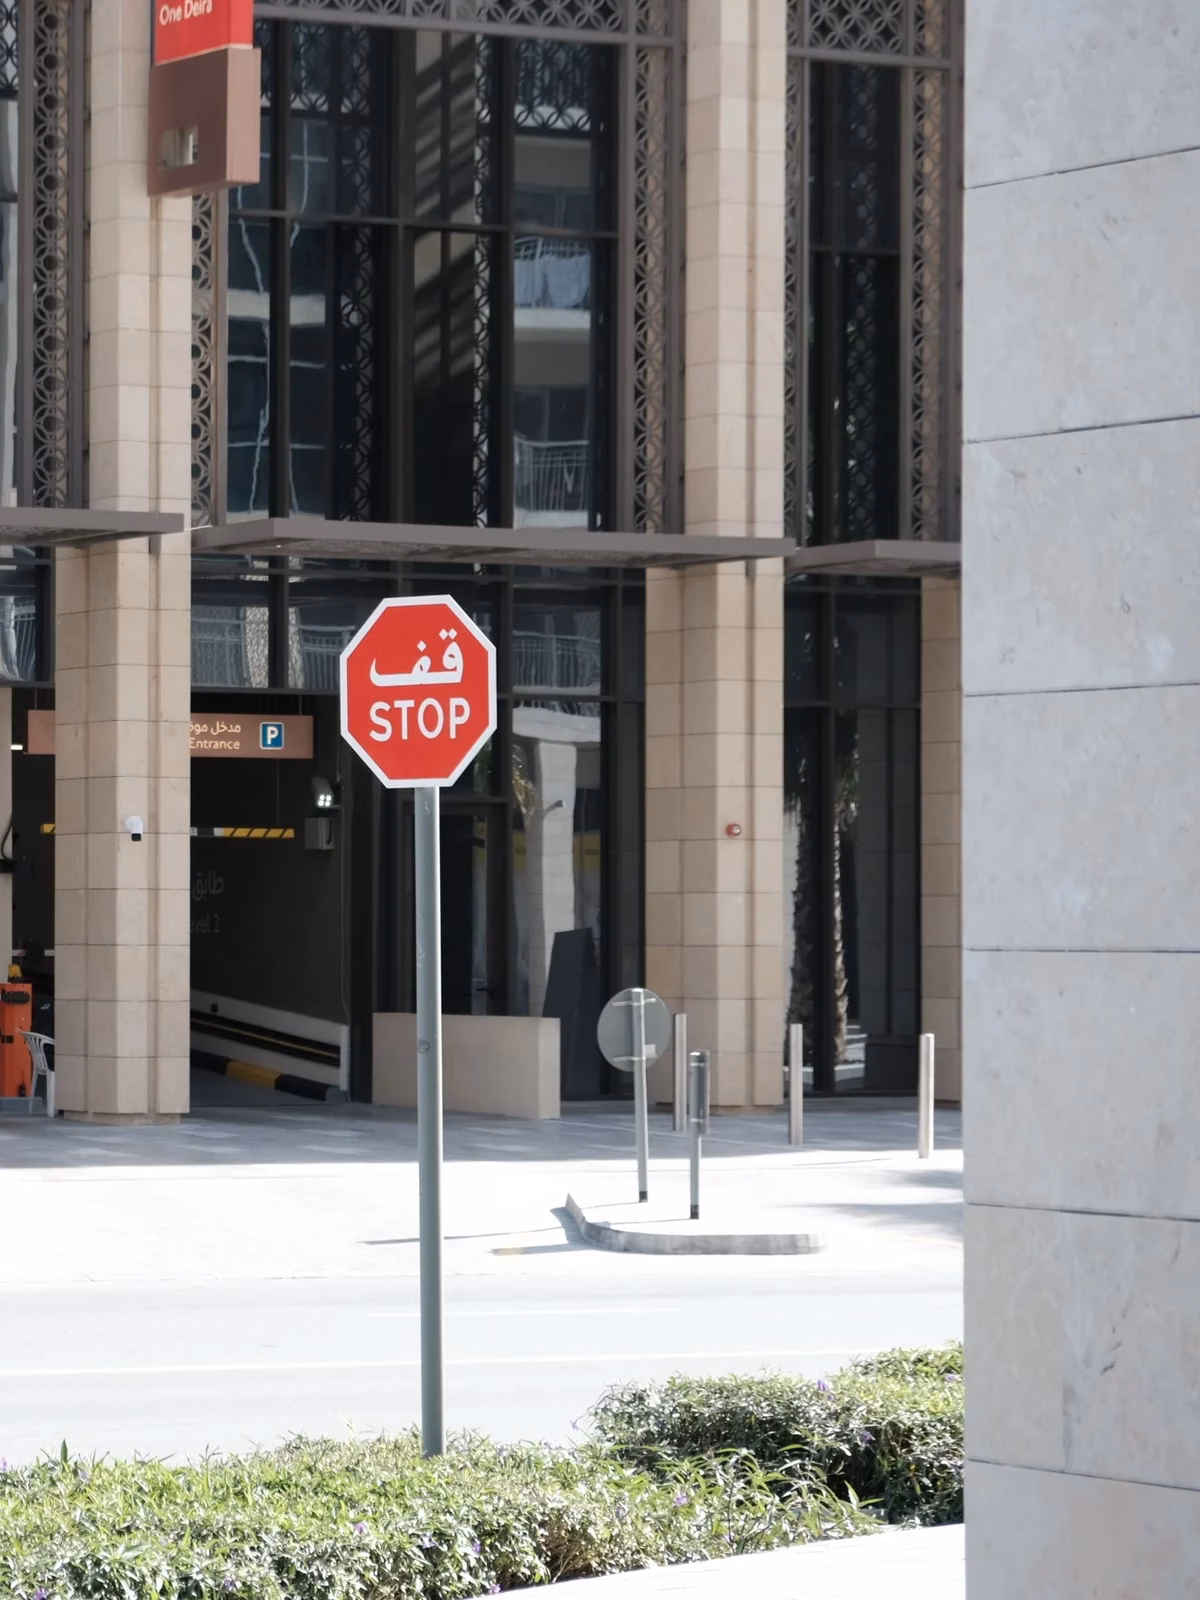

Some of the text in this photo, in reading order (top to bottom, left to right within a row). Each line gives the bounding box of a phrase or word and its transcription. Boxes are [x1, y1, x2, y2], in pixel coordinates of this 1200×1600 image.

[160, 0, 213, 26] One Deira
[369, 628, 464, 687] قف
[210, 720, 242, 736] مدخل
[369, 697, 471, 742] STOP
[190, 737, 241, 750] Entrance
[266, 725, 279, 745] P
[191, 870, 225, 902] طابق
[213, 912, 222, 934] 2
